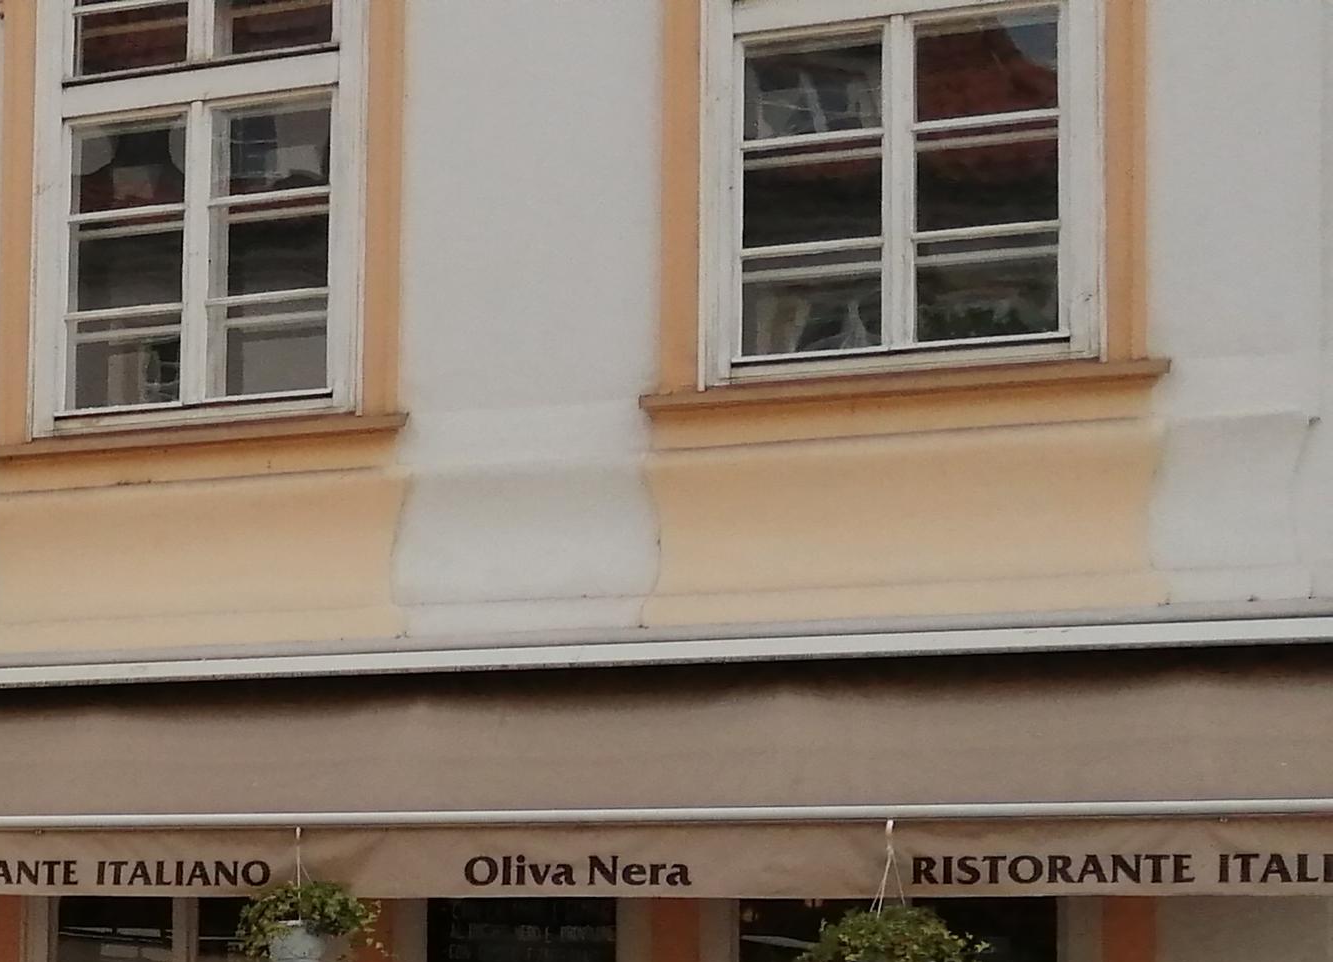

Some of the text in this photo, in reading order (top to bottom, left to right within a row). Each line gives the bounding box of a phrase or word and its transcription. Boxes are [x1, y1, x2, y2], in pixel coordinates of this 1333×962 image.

[96, 859, 272, 887] ITALIANO
[464, 854, 692, 887] Oliva Nera
[911, 854, 1196, 886] RISTORANTE
